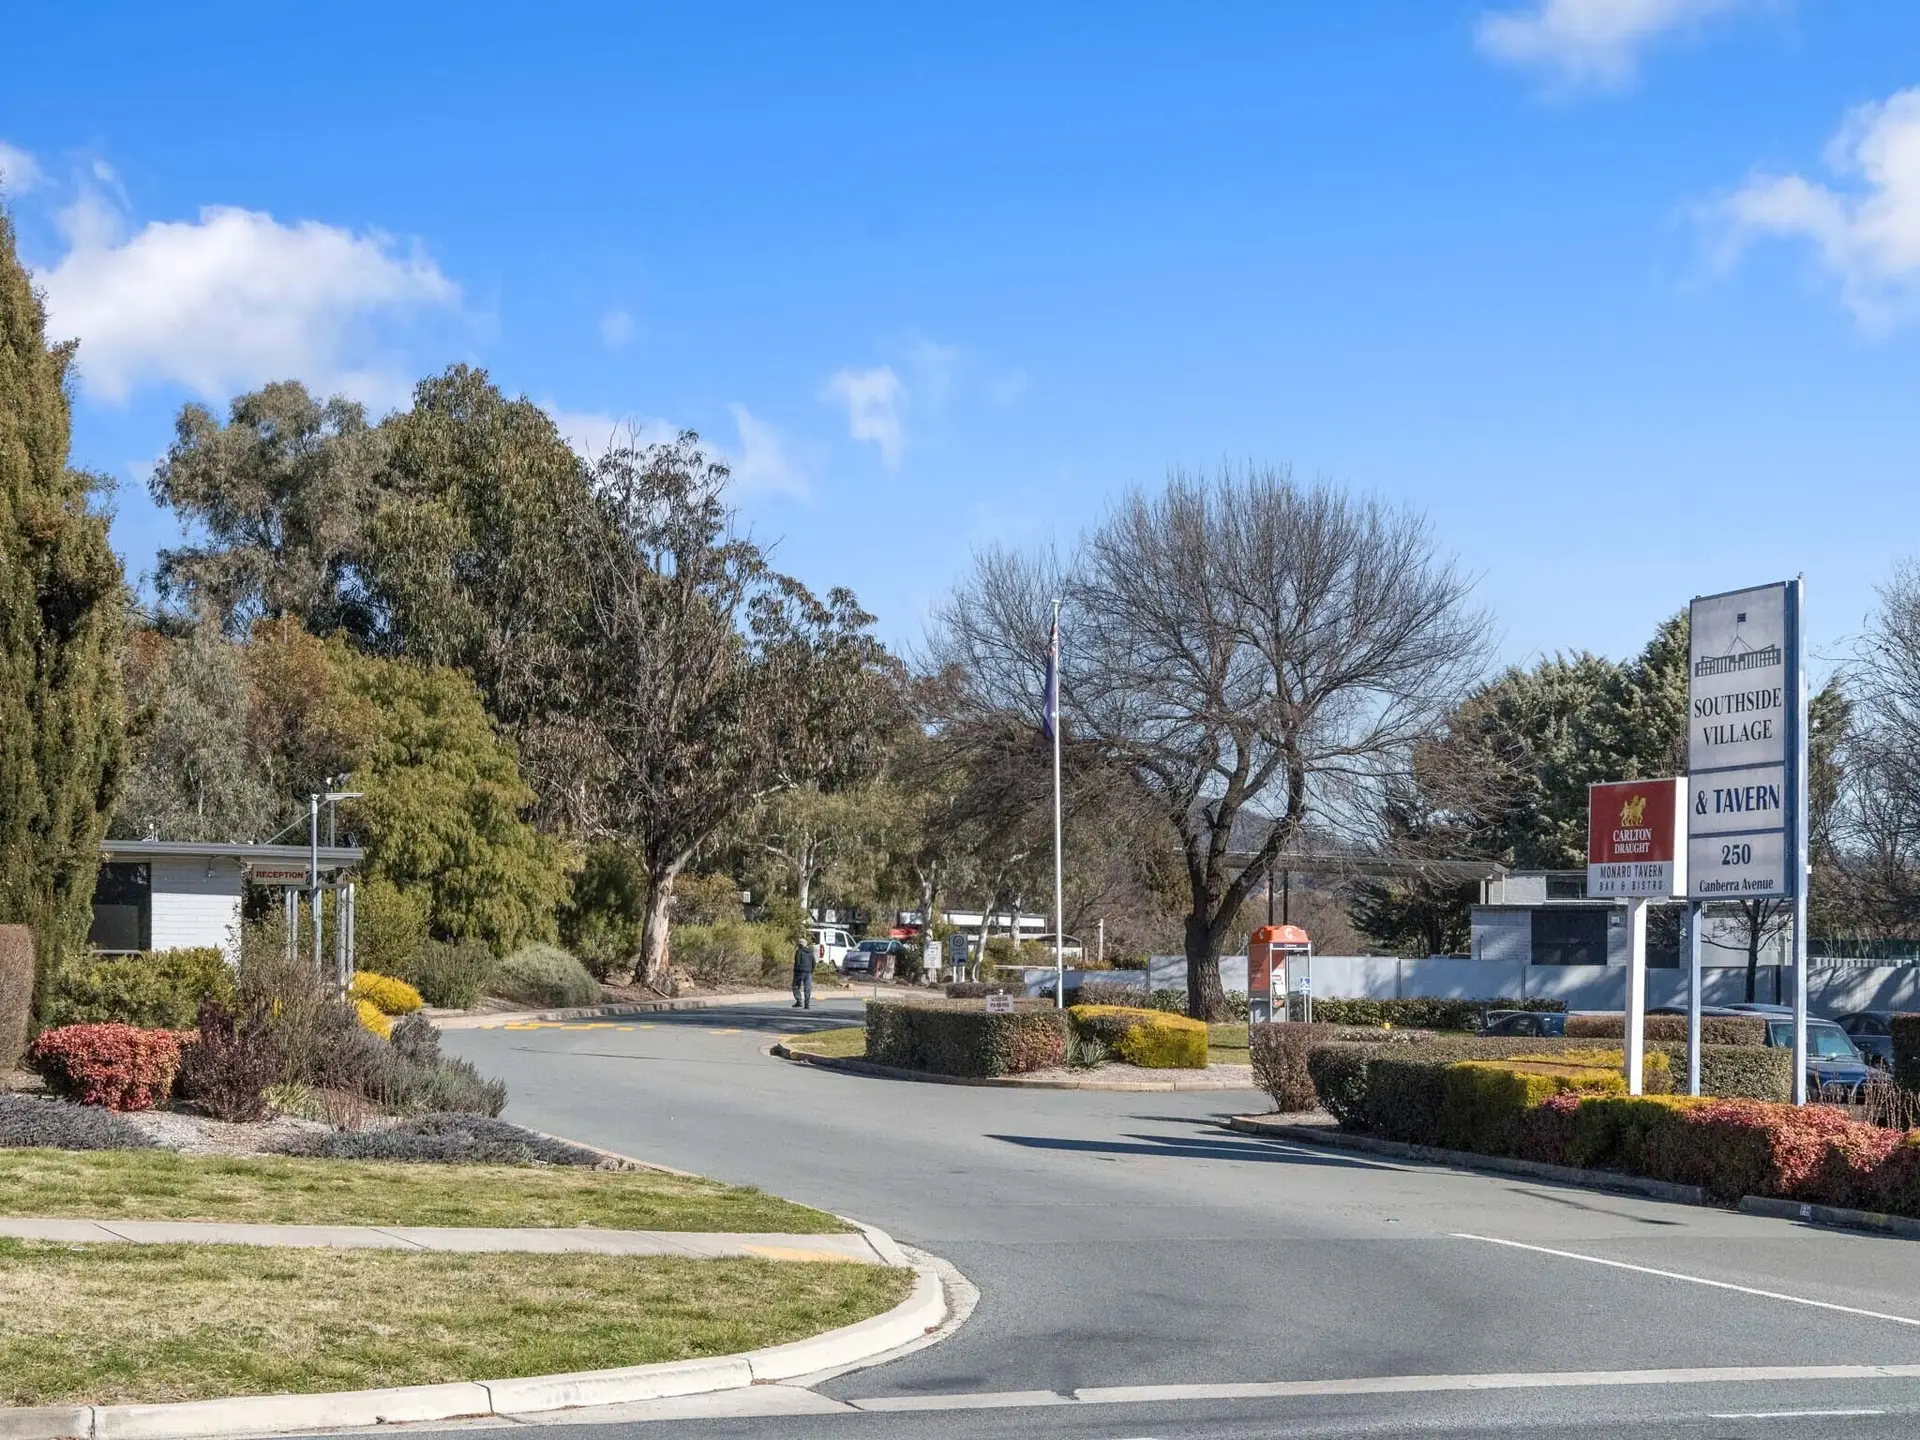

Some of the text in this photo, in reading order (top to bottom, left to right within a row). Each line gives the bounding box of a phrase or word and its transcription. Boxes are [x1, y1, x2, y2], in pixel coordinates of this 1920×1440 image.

[1694, 688, 1781, 718] SOUTHSIDE
[1703, 720, 1772, 746] VILLAGE
[1695, 784, 1780, 815] & TAVERN
[1612, 828, 1652, 842] CARLTON
[1614, 842, 1650, 854] DRAUGHT
[1721, 843, 1751, 866] 250
[256, 870, 304, 879] RECEPTION
[1600, 863, 1663, 879] MONARO TAVERN
[1600, 881, 1615, 891] BAR
[1631, 880, 1663, 890] BISTRO
[1699, 877, 1774, 893] Canberra Avenue
